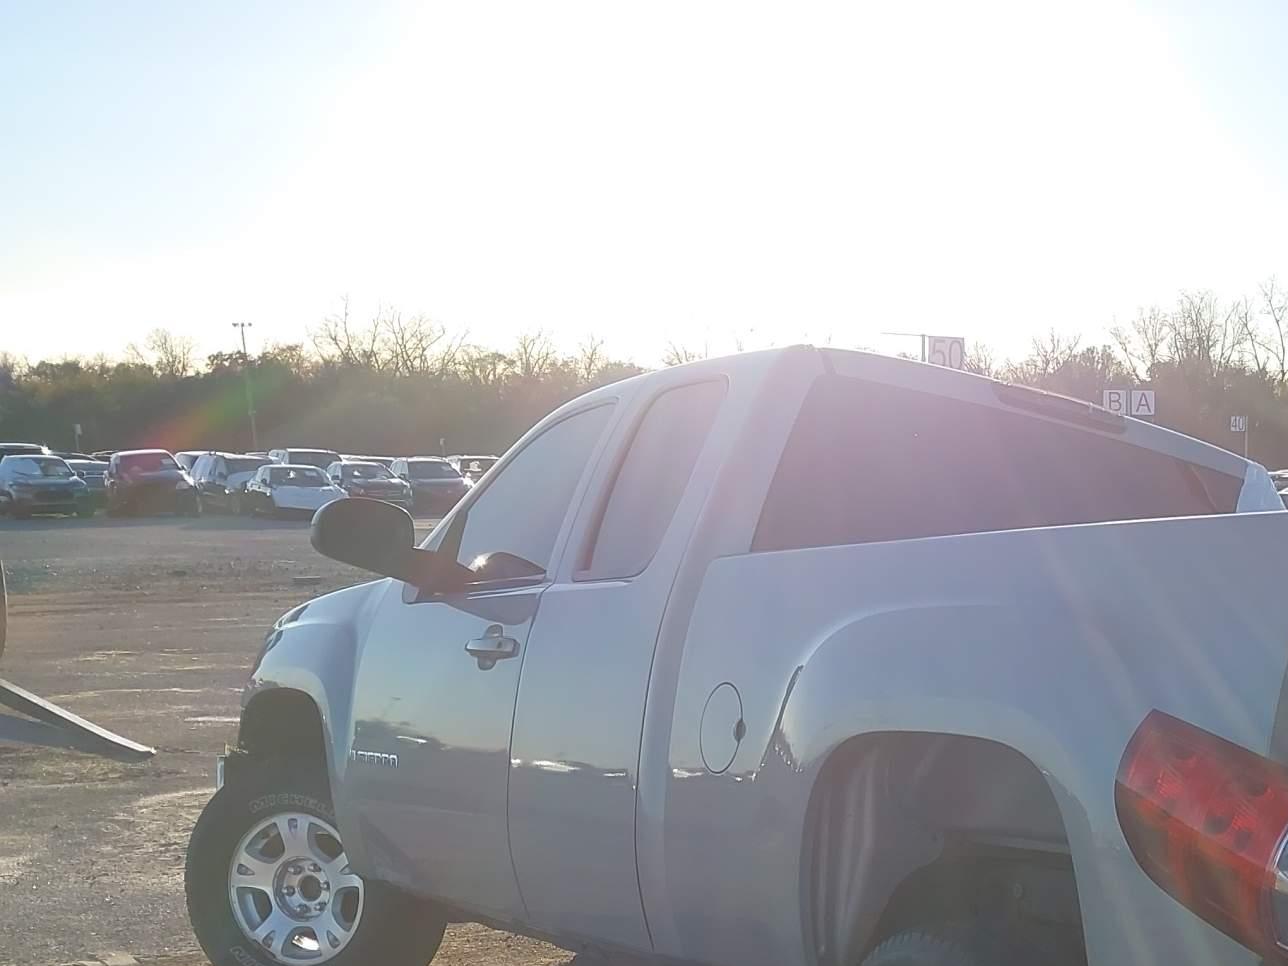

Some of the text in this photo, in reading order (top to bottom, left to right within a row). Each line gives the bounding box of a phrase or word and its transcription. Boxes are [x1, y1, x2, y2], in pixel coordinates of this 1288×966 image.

[932, 339, 963, 369] 50
[1108, 391, 1122, 412] B
[1135, 391, 1152, 413] A
[1231, 416, 1245, 431] 40
